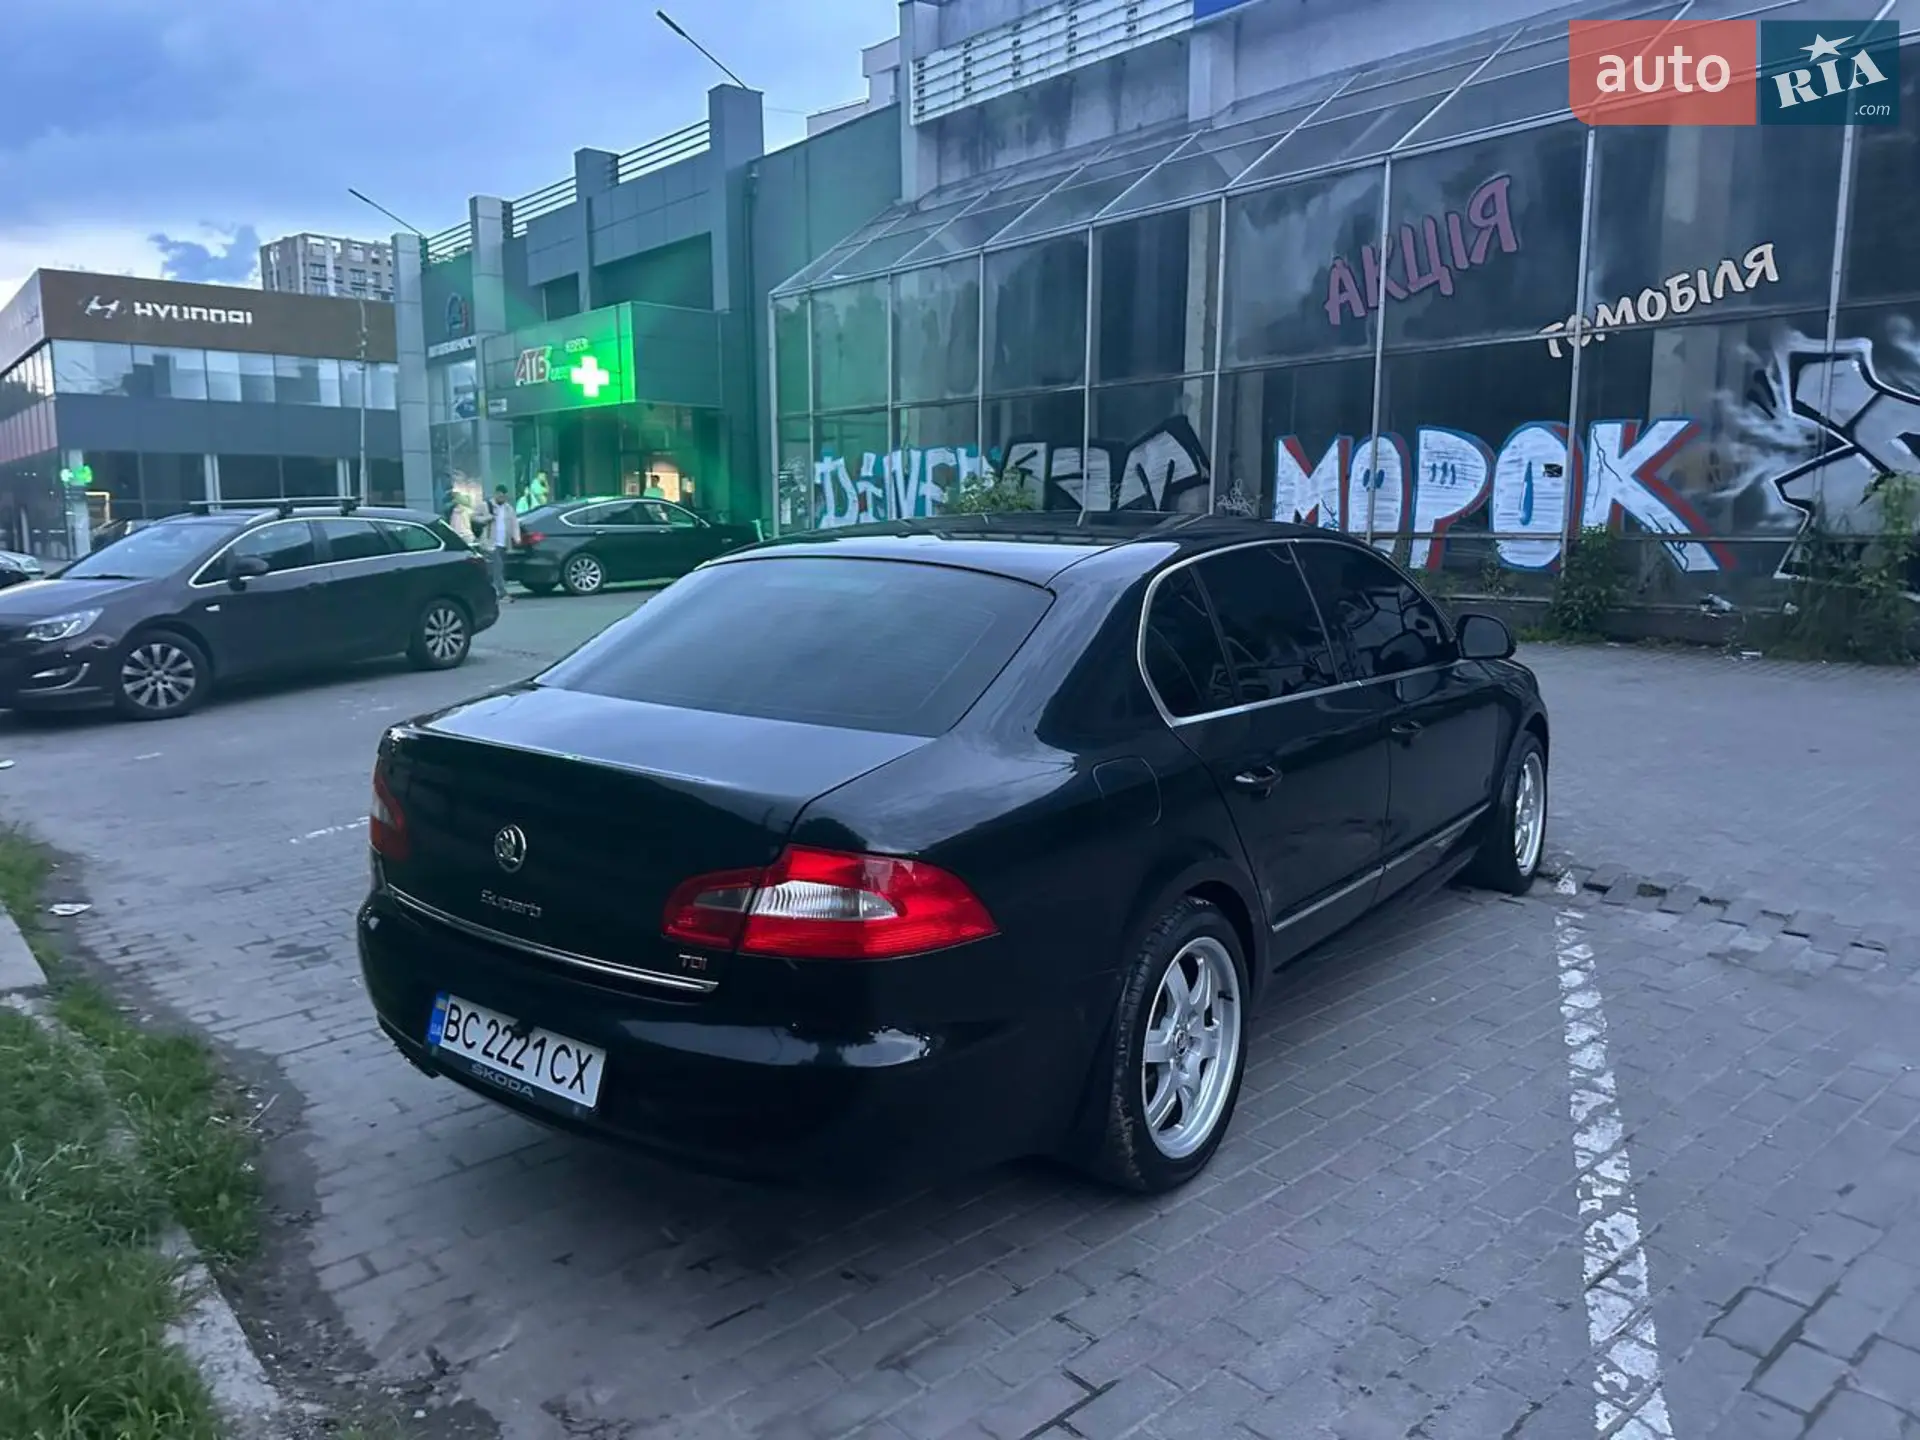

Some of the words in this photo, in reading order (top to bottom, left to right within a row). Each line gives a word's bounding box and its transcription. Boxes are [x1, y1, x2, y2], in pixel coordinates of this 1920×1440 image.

[1324, 175, 1518, 325] АКЦІЯ
[133, 301, 253, 324] HYUNDAI
[679, 954, 707, 970] TDI
